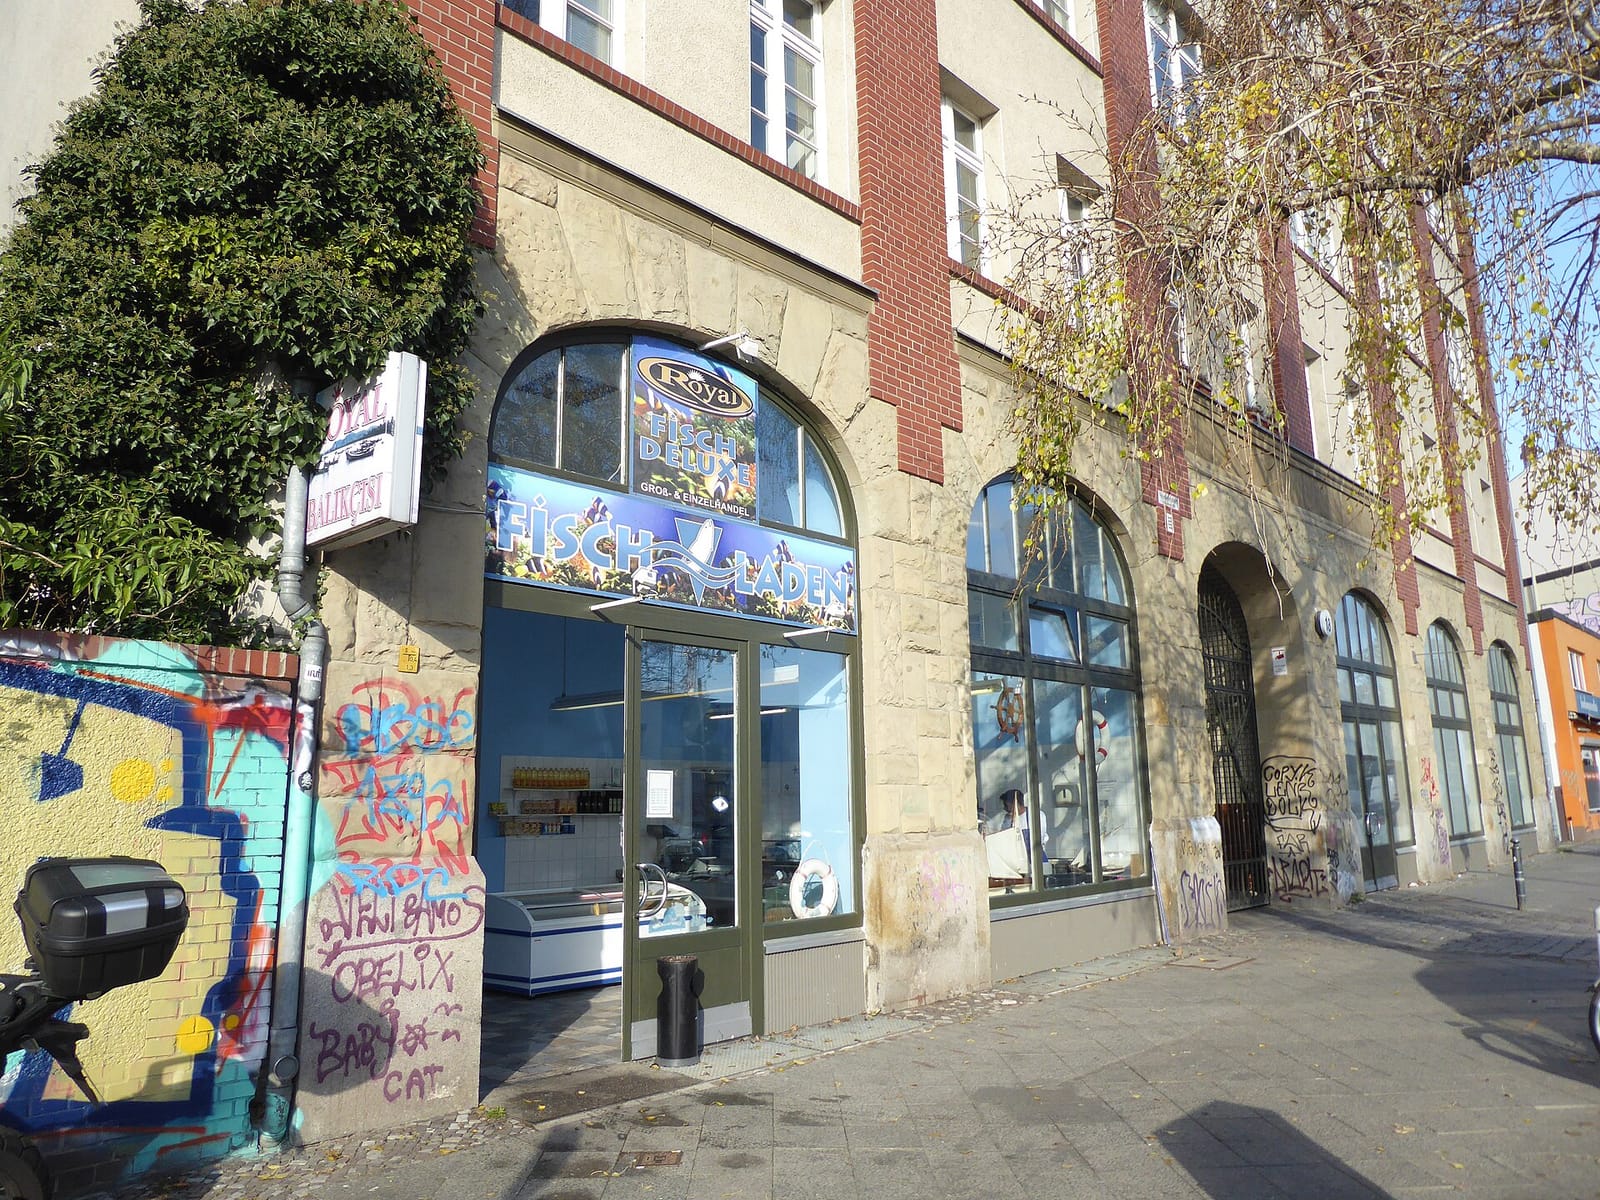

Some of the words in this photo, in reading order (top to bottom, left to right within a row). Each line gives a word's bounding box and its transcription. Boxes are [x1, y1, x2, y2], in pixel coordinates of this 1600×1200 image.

[656, 362, 738, 407] Royal
[325, 383, 387, 442] OYAL
[639, 435, 751, 487] DELUXE
[673, 490, 681, 500] &
[682, 492, 750, 517] EINZELHANDEL
[734, 549, 848, 611] LADEN
[310, 998, 401, 1084] BABY
[383, 1063, 444, 1103] CAT
